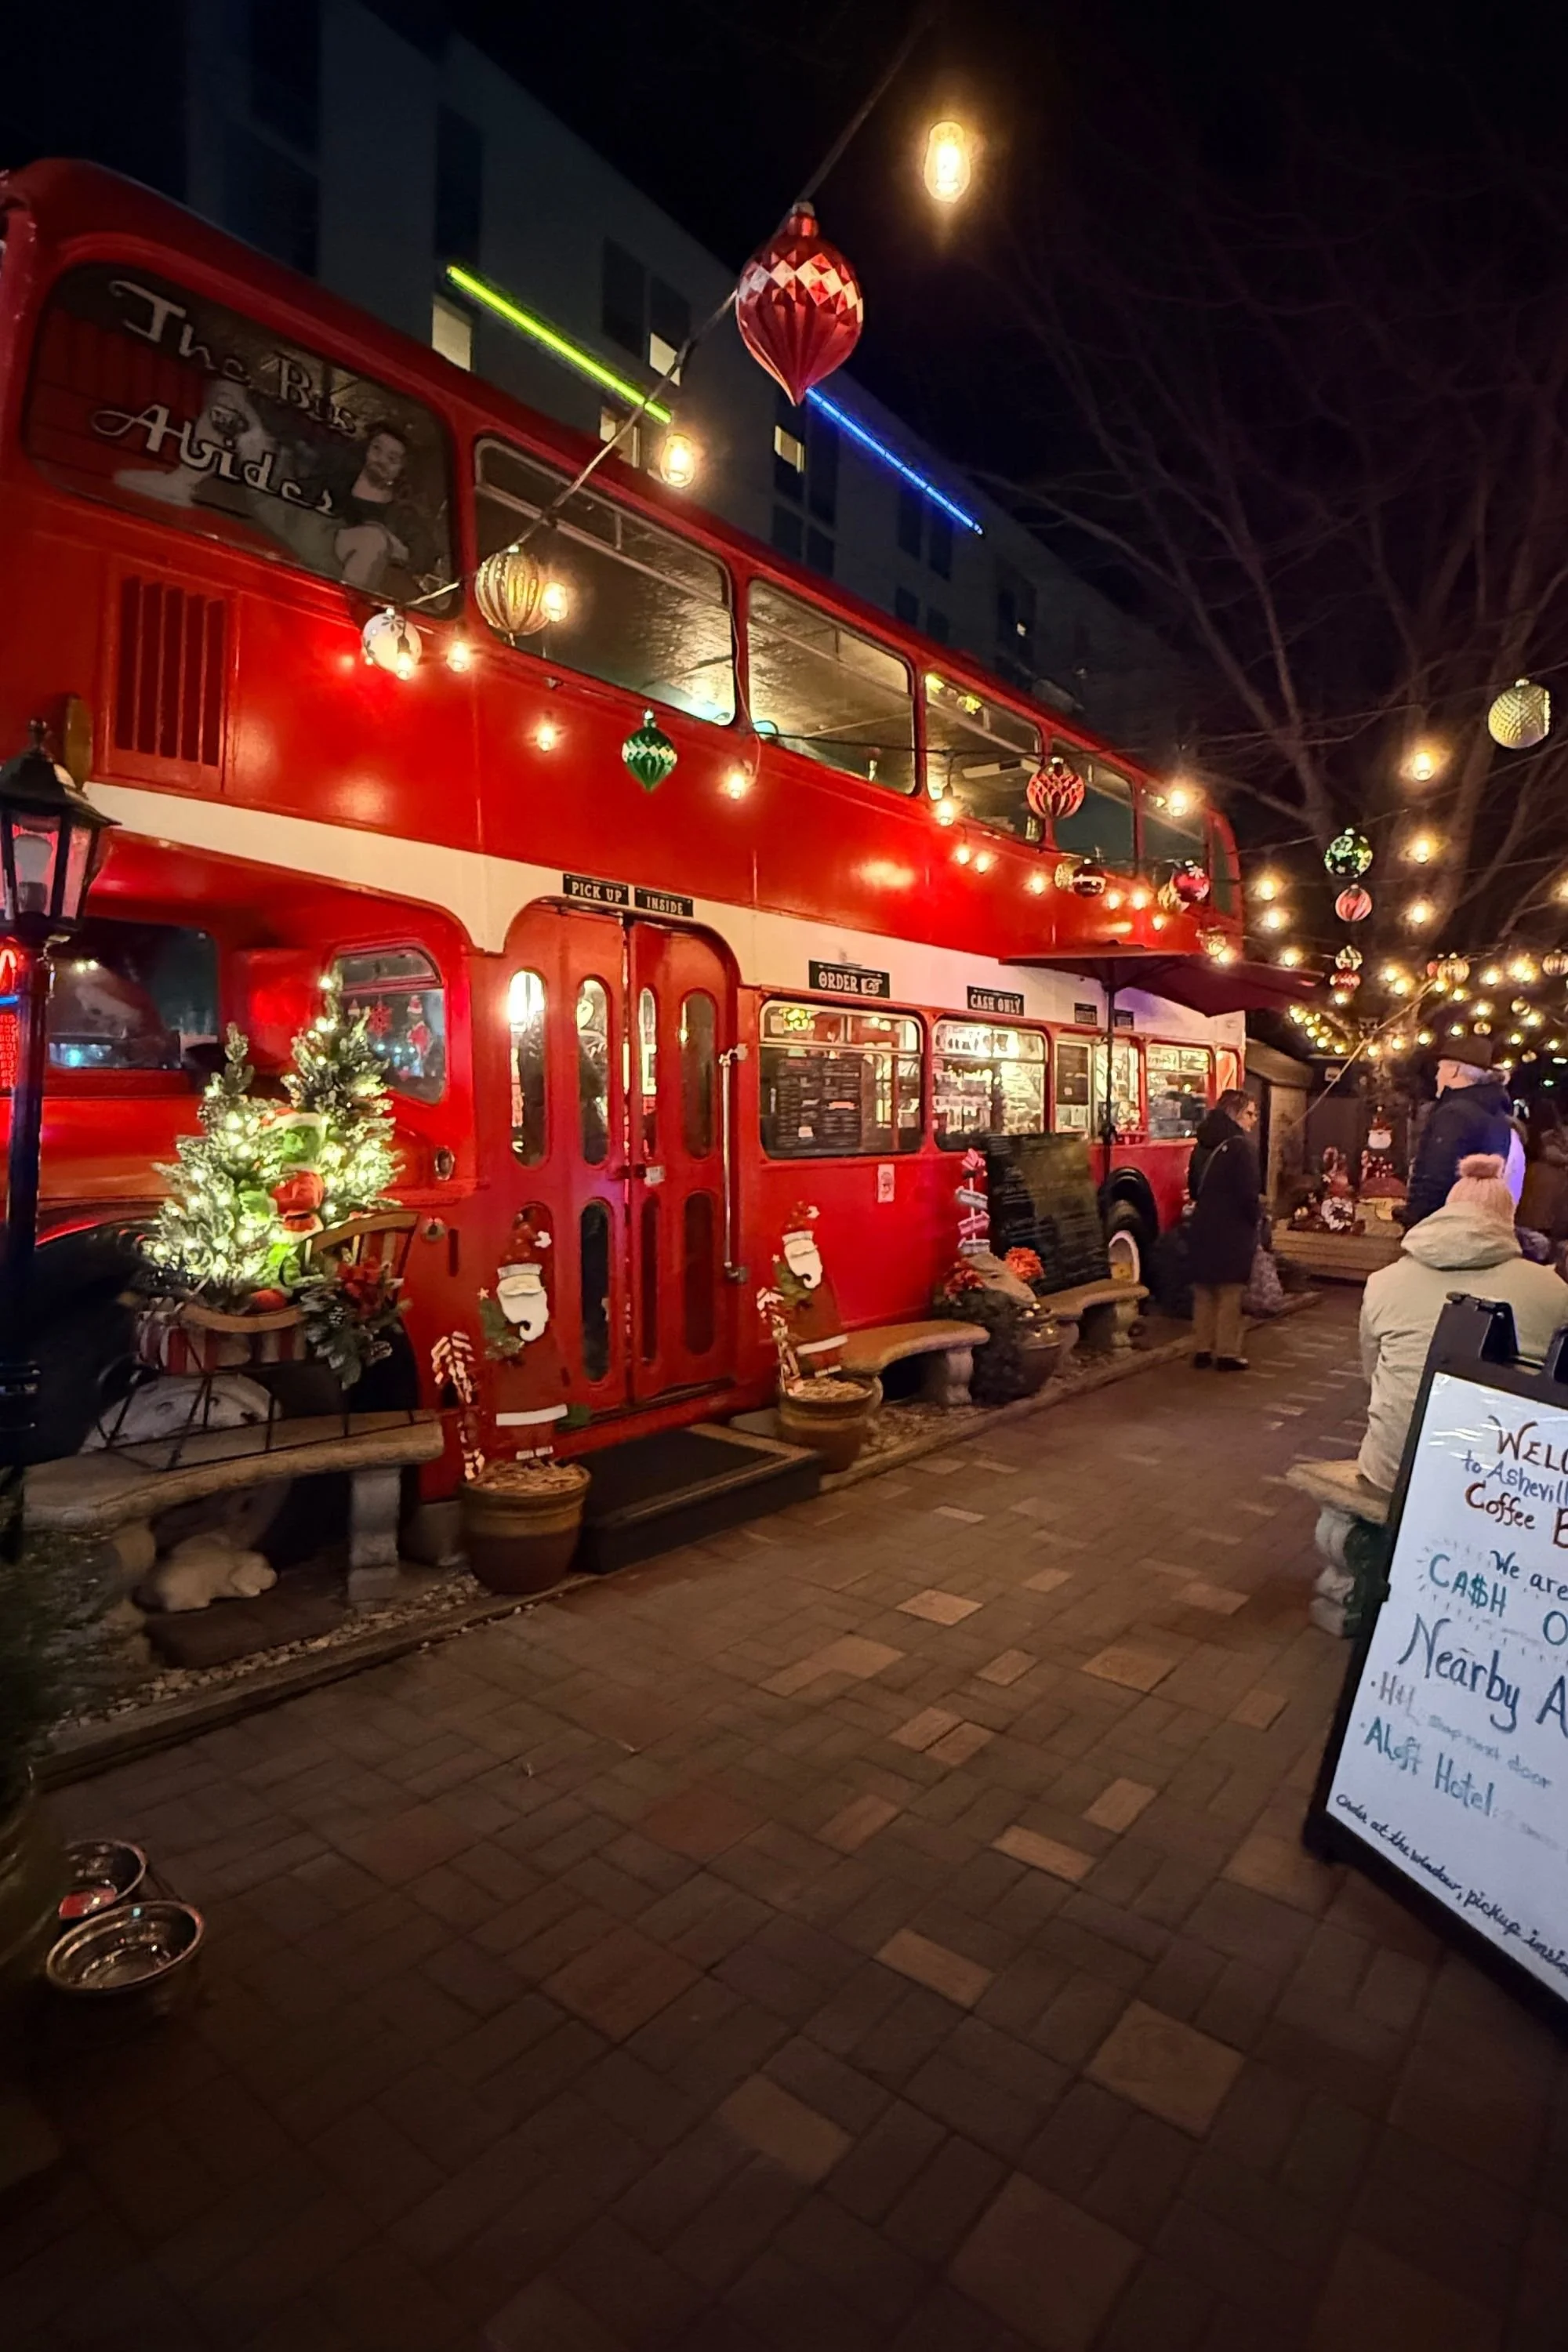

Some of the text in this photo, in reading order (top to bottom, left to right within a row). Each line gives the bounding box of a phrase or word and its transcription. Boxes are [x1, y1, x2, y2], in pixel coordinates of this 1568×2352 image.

[108, 279, 252, 385] The
[572, 881, 622, 903] PICK UP
[645, 895, 684, 916] INSIDE
[818, 971, 858, 993] ORDER
[970, 993, 1021, 1014] CASH ONLY
[1461, 1449, 1483, 1474] to
[1465, 1479, 1536, 1530] Coffee
[1489, 1549, 1568, 1602] We are
[1396, 1613, 1520, 1734] Nearby
